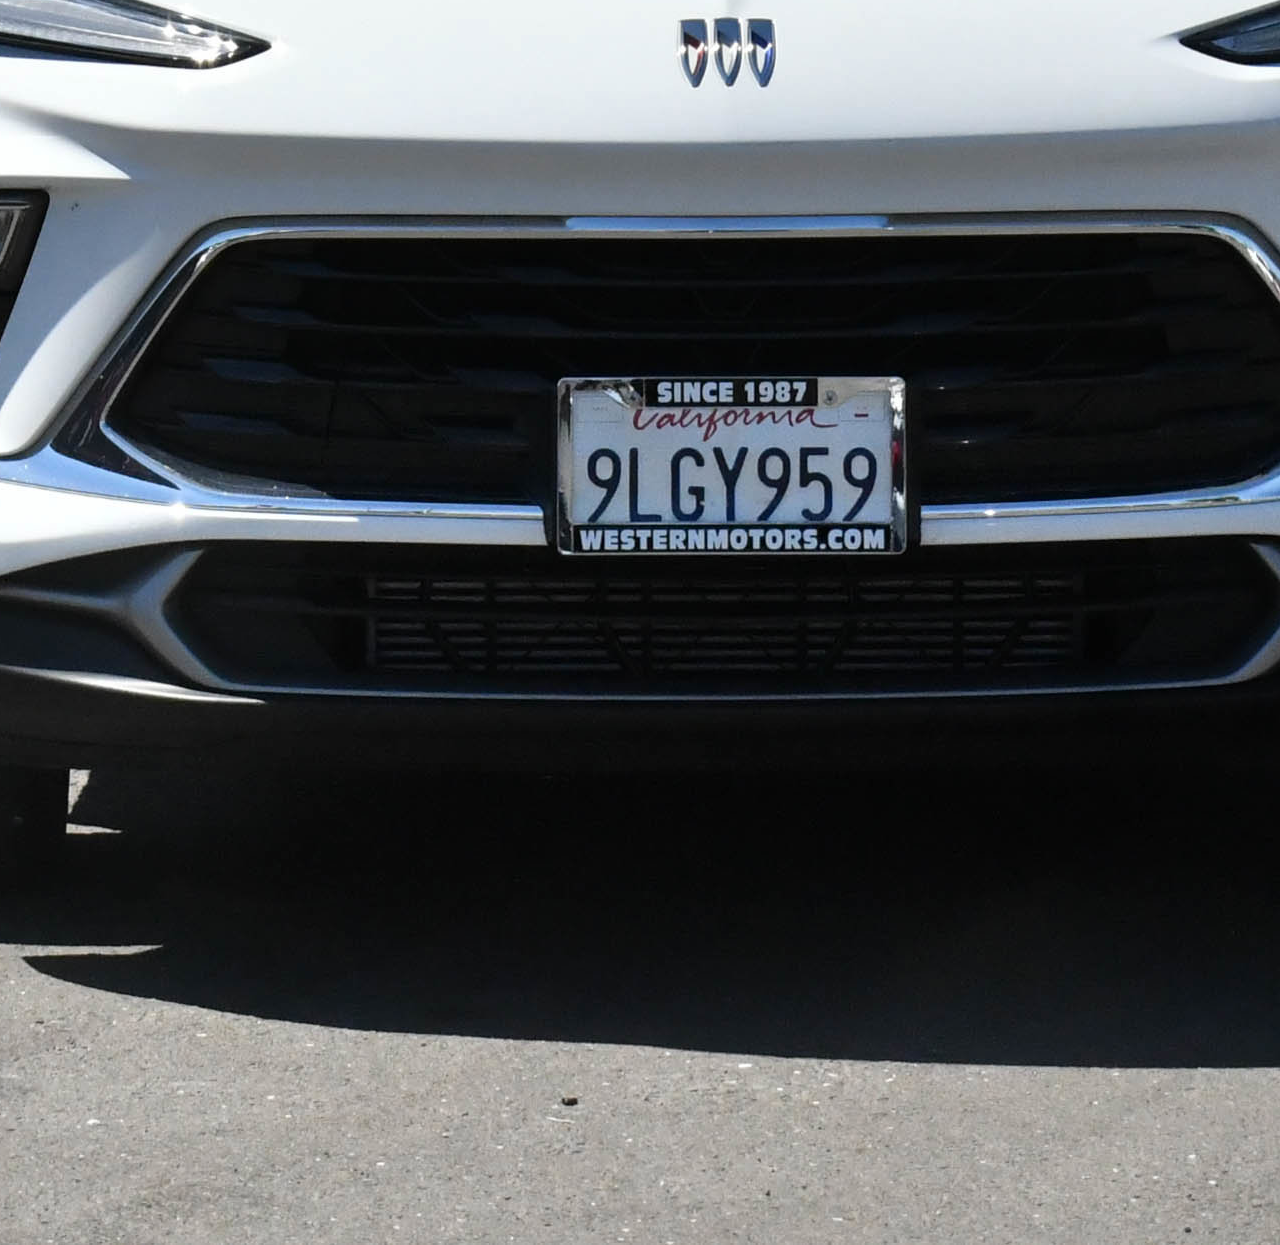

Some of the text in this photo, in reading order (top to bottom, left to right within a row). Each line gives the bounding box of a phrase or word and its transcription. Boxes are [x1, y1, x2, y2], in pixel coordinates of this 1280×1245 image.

[658, 382, 806, 402] SINCE 1987
[632, 408, 838, 442] California
[587, 447, 878, 523] 9LGY959
[580, 529, 884, 550] WESTERNMOTORS.COM
